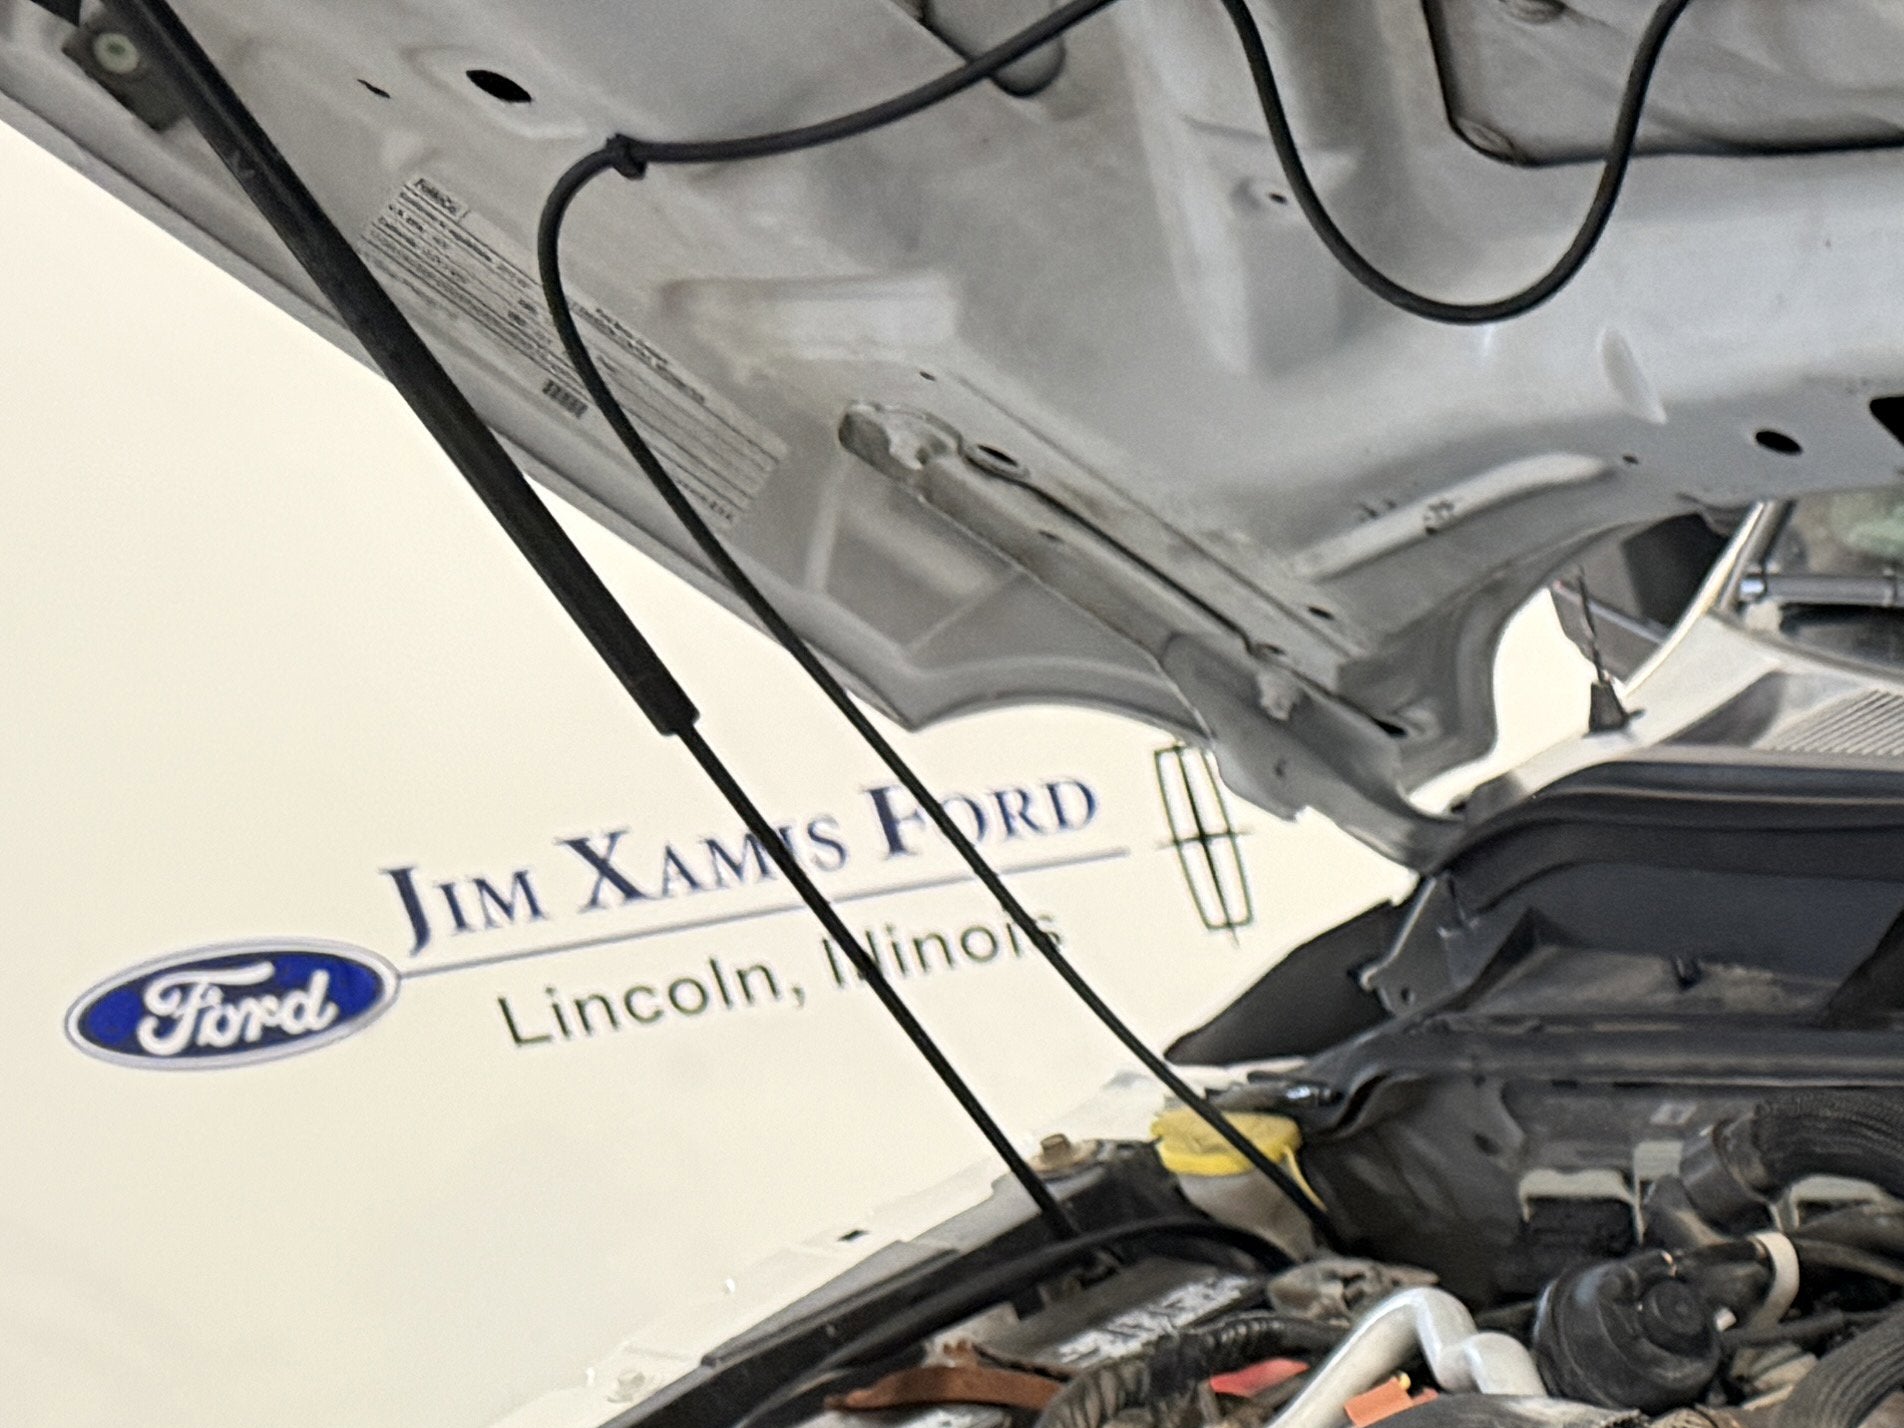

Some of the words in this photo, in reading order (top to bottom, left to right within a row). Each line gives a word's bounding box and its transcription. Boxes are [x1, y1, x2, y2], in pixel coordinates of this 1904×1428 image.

[556, 812, 850, 913] XAMIS
[860, 776, 1100, 860] FORD
[137, 963, 338, 1058] Ford
[497, 952, 809, 1048] Lincoln,
[821, 911, 1064, 989] Ilinois
